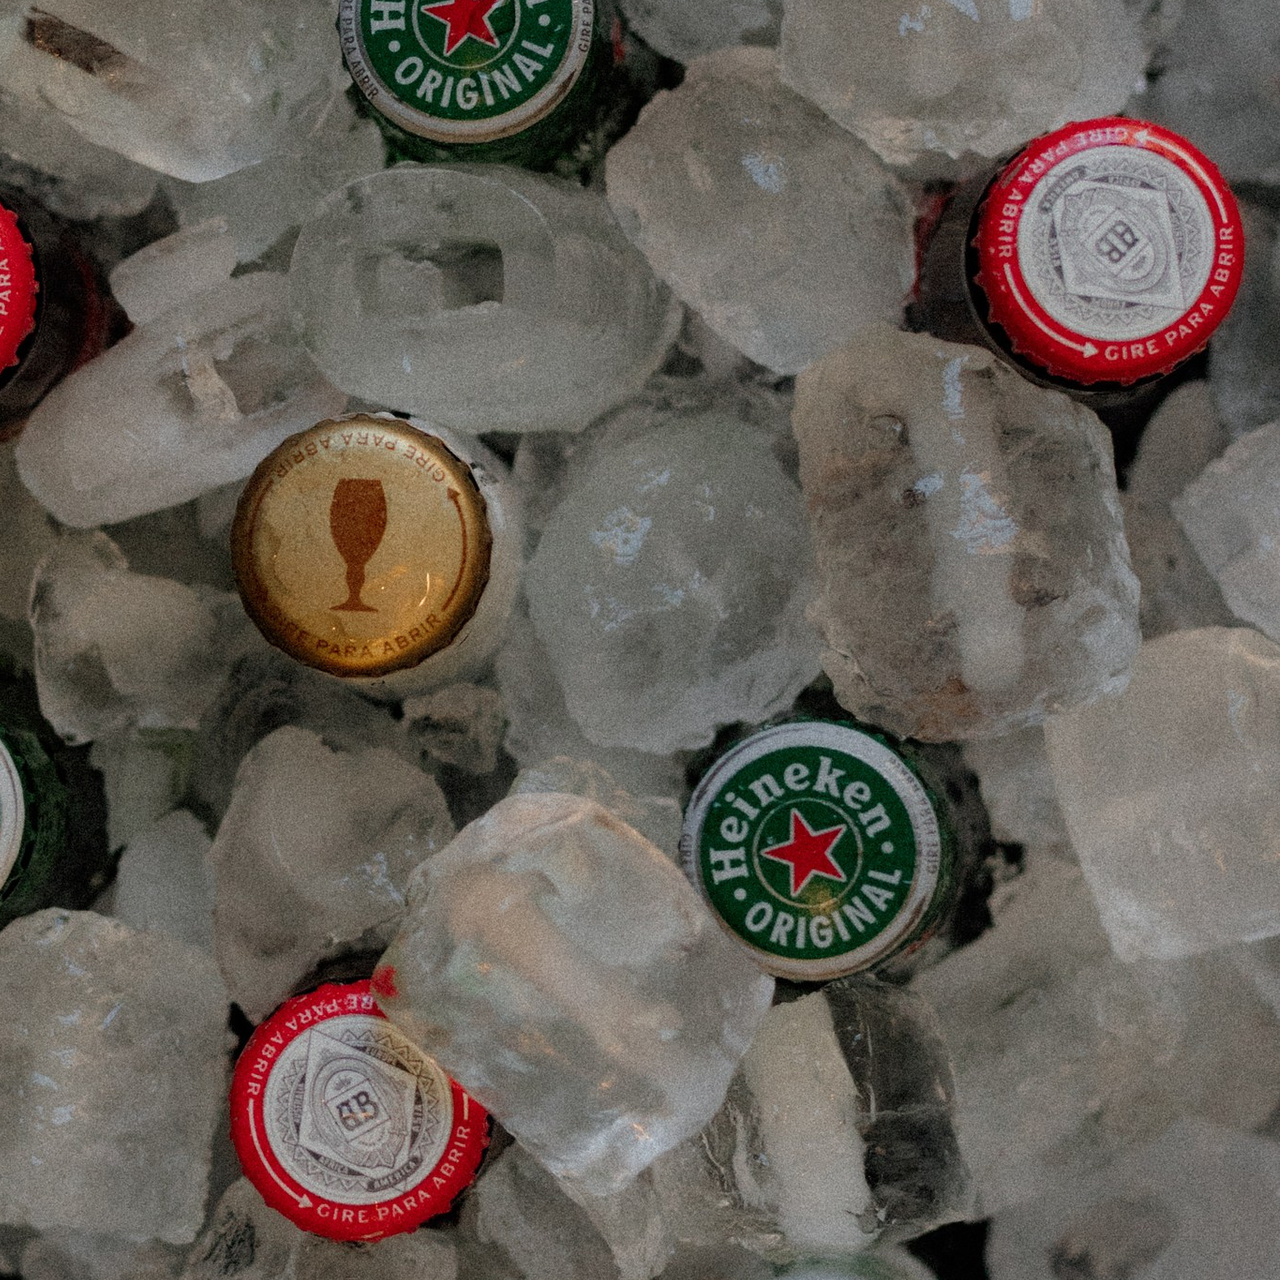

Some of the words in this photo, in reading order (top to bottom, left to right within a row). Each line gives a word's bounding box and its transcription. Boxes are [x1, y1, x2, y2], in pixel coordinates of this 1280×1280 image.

[575, 20, 593, 53] GIRE
[393, 40, 555, 111] ORIGINAL
[1073, 126, 1127, 148] GIRE
[1018, 139, 1068, 185] PARA
[998, 187, 1025, 257] ABRIR
[1104, 338, 1159, 359] GIRE
[1164, 300, 1214, 347] PARA
[1208, 225, 1233, 298] ABRIR
[271, 437, 330, 479] ABRIR
[341, 432, 397, 451] PARA
[402, 444, 448, 484] GIRE
[315, 637, 372, 657] PARA
[382, 612, 441, 654] ABRIR
[709, 755, 898, 885] Heineken
[745, 865, 902, 949] ORIGINAL
[283, 996, 339, 1033] PARA
[247, 1030, 285, 1095] ABRIR
[315, 1201, 367, 1223] GIRE
[376, 1186, 431, 1220] PARA
[429, 1125, 471, 1189] ABRIR
